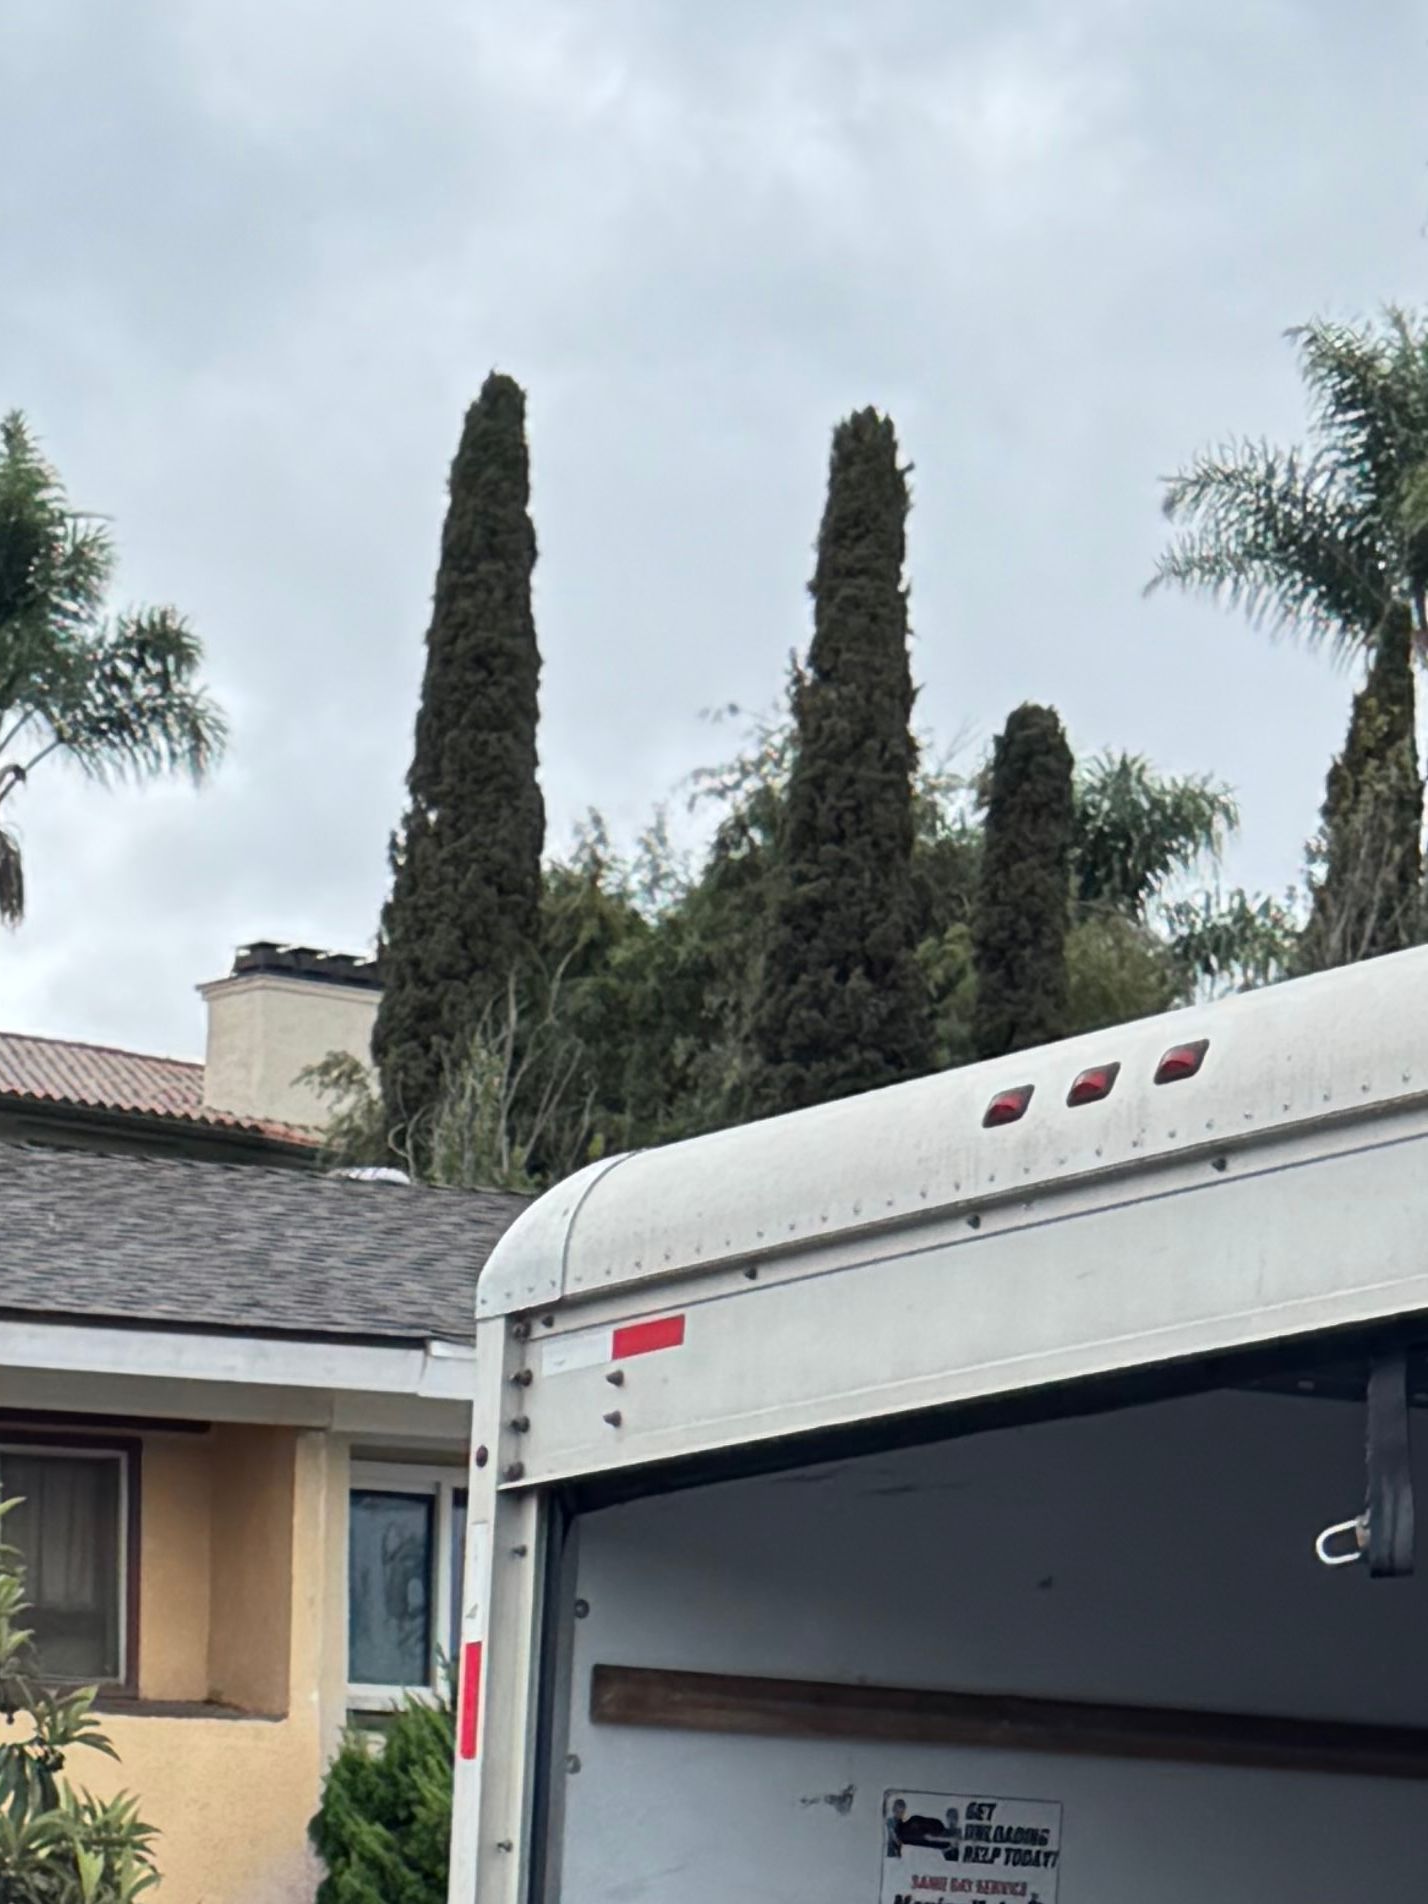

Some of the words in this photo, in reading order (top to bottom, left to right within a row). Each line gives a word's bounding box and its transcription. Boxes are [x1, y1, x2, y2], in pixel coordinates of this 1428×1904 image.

[966, 1801, 998, 1821] GET
[964, 1823, 1051, 1847] UNLOADING
[963, 1845, 1002, 1865] HELP
